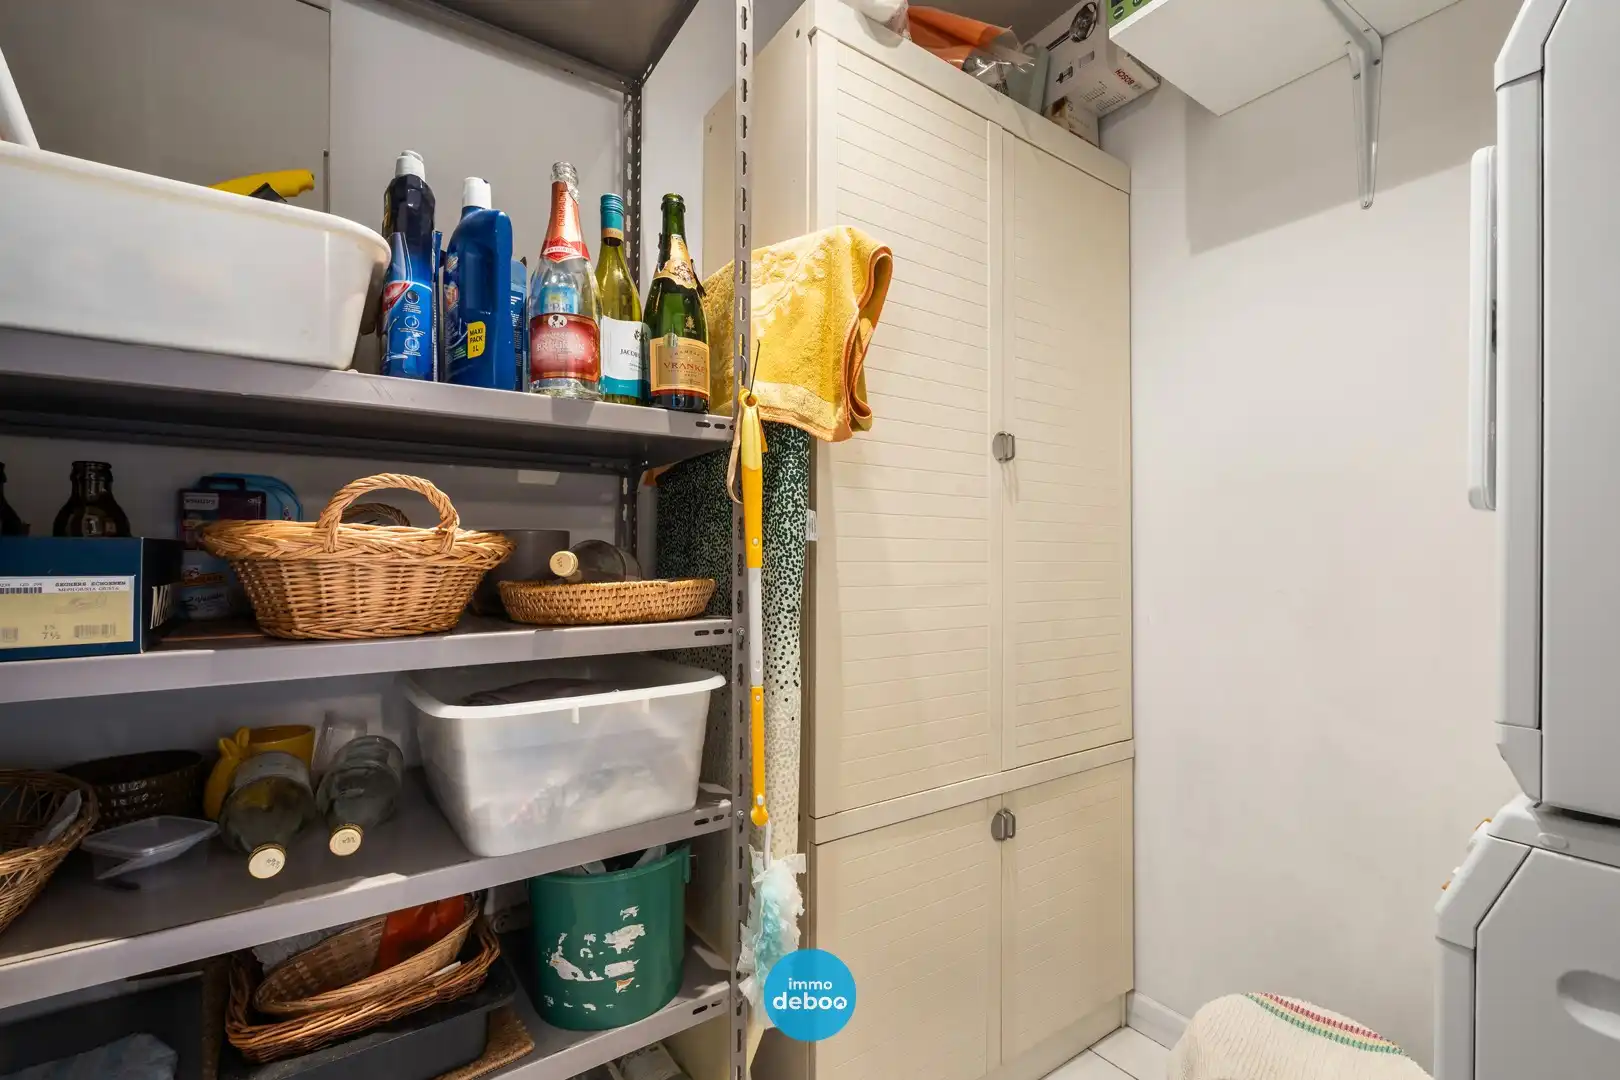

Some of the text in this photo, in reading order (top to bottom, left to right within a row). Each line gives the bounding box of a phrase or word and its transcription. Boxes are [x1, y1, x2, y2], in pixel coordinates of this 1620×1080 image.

[1115, 69, 1135, 85] BOSCH
[470, 328, 483, 336] MAXI
[470, 336, 483, 344] PACK
